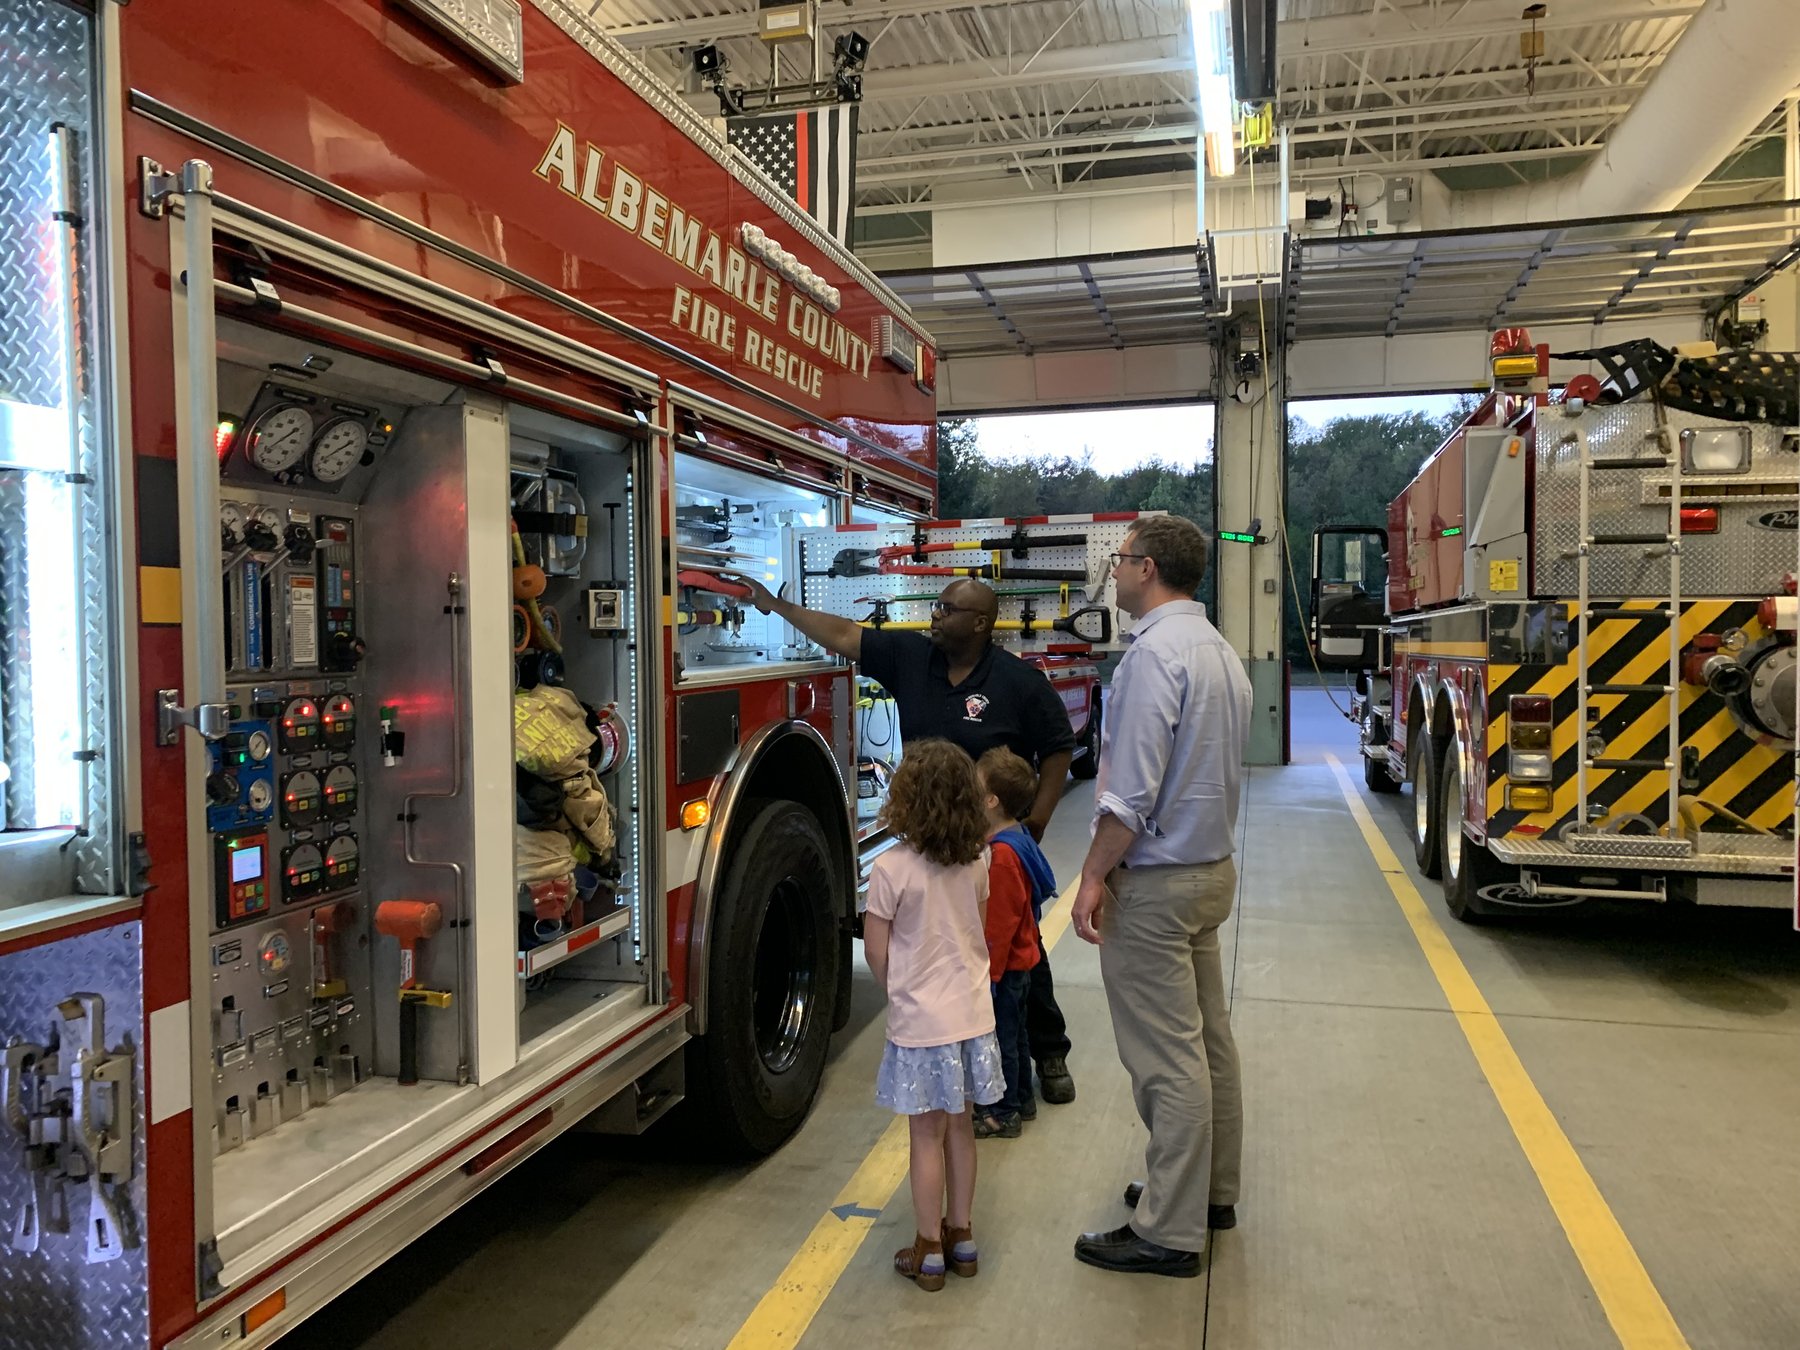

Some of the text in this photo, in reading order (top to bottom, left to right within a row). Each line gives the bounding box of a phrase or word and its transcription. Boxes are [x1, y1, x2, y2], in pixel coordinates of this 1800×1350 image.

[533, 119, 873, 381] ALBEMARLE COUNTY
[670, 283, 824, 400] FIRE RESCUE
